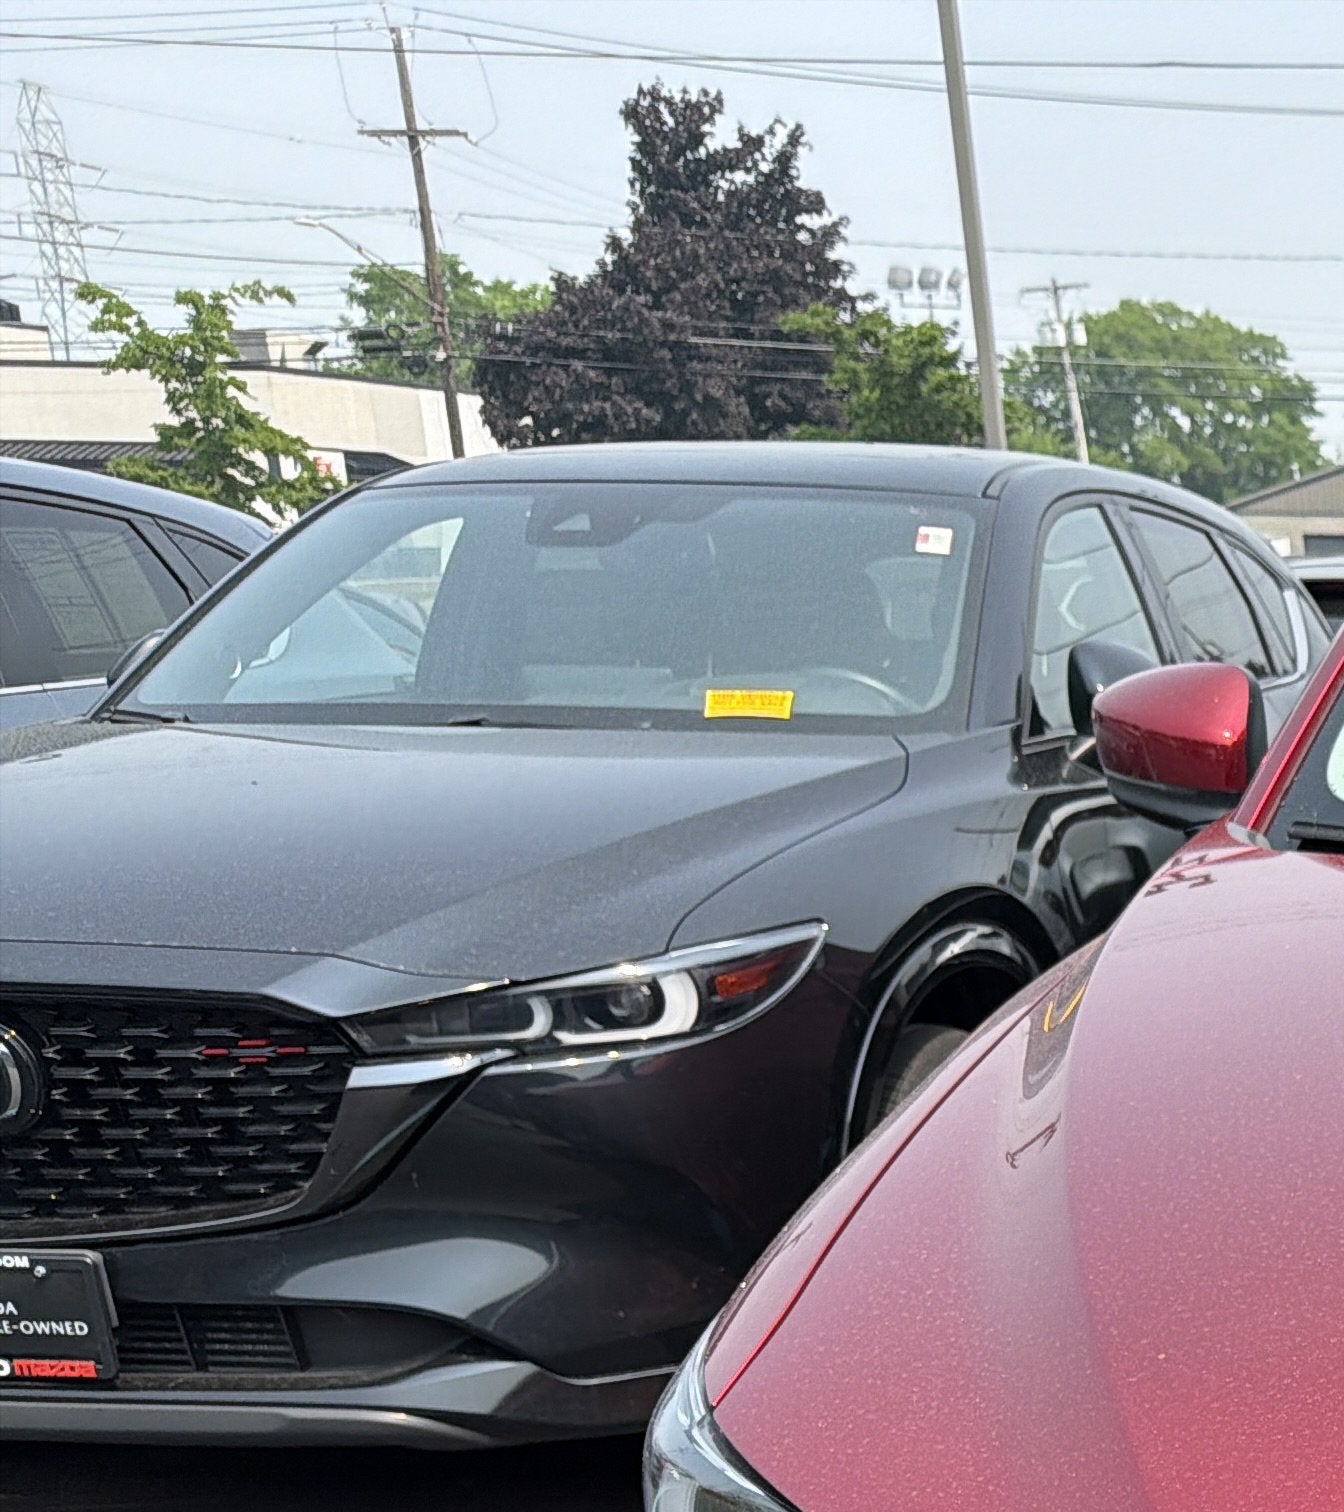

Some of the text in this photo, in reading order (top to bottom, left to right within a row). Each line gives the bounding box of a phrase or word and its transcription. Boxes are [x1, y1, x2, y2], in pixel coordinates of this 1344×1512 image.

[0, 1255, 30, 1268] OM
[0, 1320, 88, 1336] E-OWNED
[13, 1359, 97, 1378] mazda
